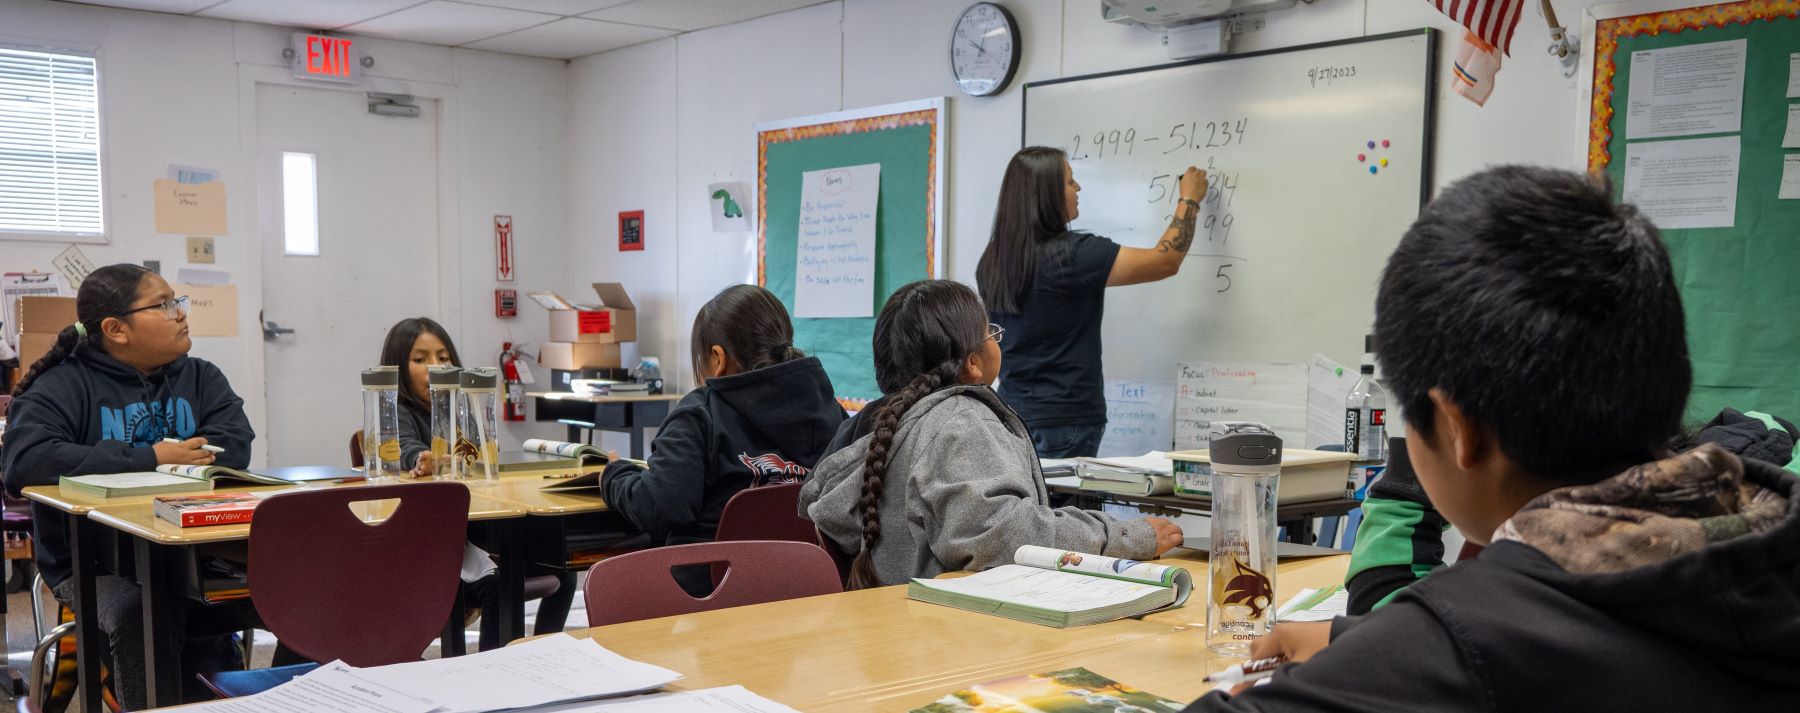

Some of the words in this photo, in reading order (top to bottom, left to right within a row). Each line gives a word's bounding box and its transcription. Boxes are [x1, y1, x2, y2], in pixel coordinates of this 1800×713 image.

[306, 35, 352, 78] EXIT
[1308, 66, 1356, 88] 9/27/2023
[1071, 127, 1136, 161] 2.999
[1163, 117, 1248, 155] 51.234
[1208, 156, 1215, 169] 2
[1217, 264, 1232, 293] 5
[1120, 384, 1147, 398] Text
[1107, 411, 1157, 423] nformation
[1346, 410, 1356, 454] ssentia
